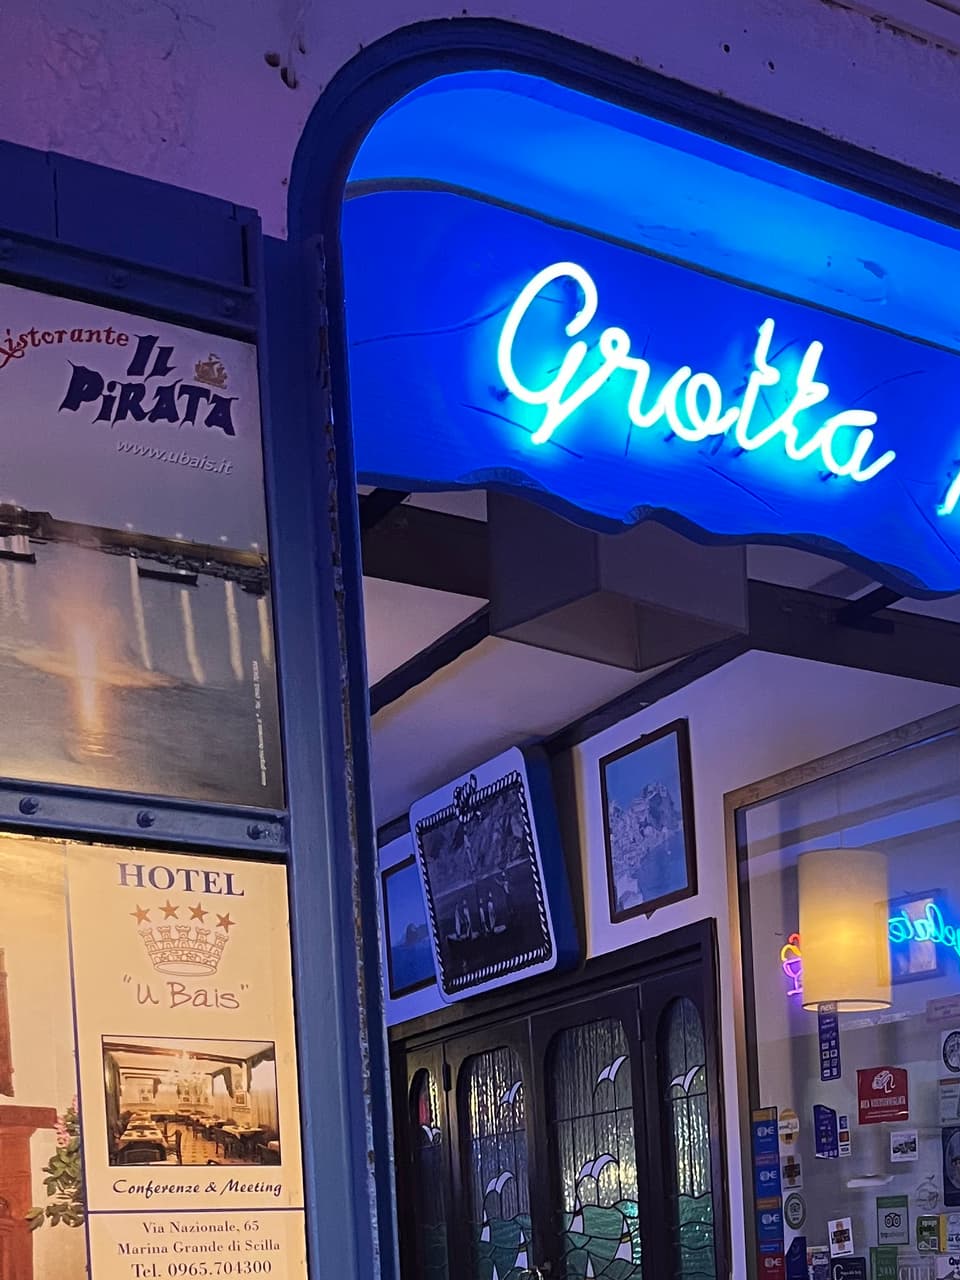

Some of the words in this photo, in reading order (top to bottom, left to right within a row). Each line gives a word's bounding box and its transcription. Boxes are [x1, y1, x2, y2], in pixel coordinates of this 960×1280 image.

[0, 326, 129, 368] istorante
[497, 262, 896, 483] Grotta
[116, 438, 233, 475] www.ubais.it
[117, 862, 245, 897] HOTEL
[113, 1179, 200, 1198] Conferenze
[204, 1181, 218, 1193] &
[220, 1179, 282, 1197] Meeting
[143, 1221, 165, 1234] Via
[243, 1220, 260, 1233] 65
[118, 1242, 168, 1255] Marina
[173, 1240, 224, 1254] Grande
[228, 1240, 241, 1252] di
[245, 1239, 281, 1251] Scilla
[131, 1263, 161, 1279] Tel.
[168, 1260, 272, 1277] 0965.704300
